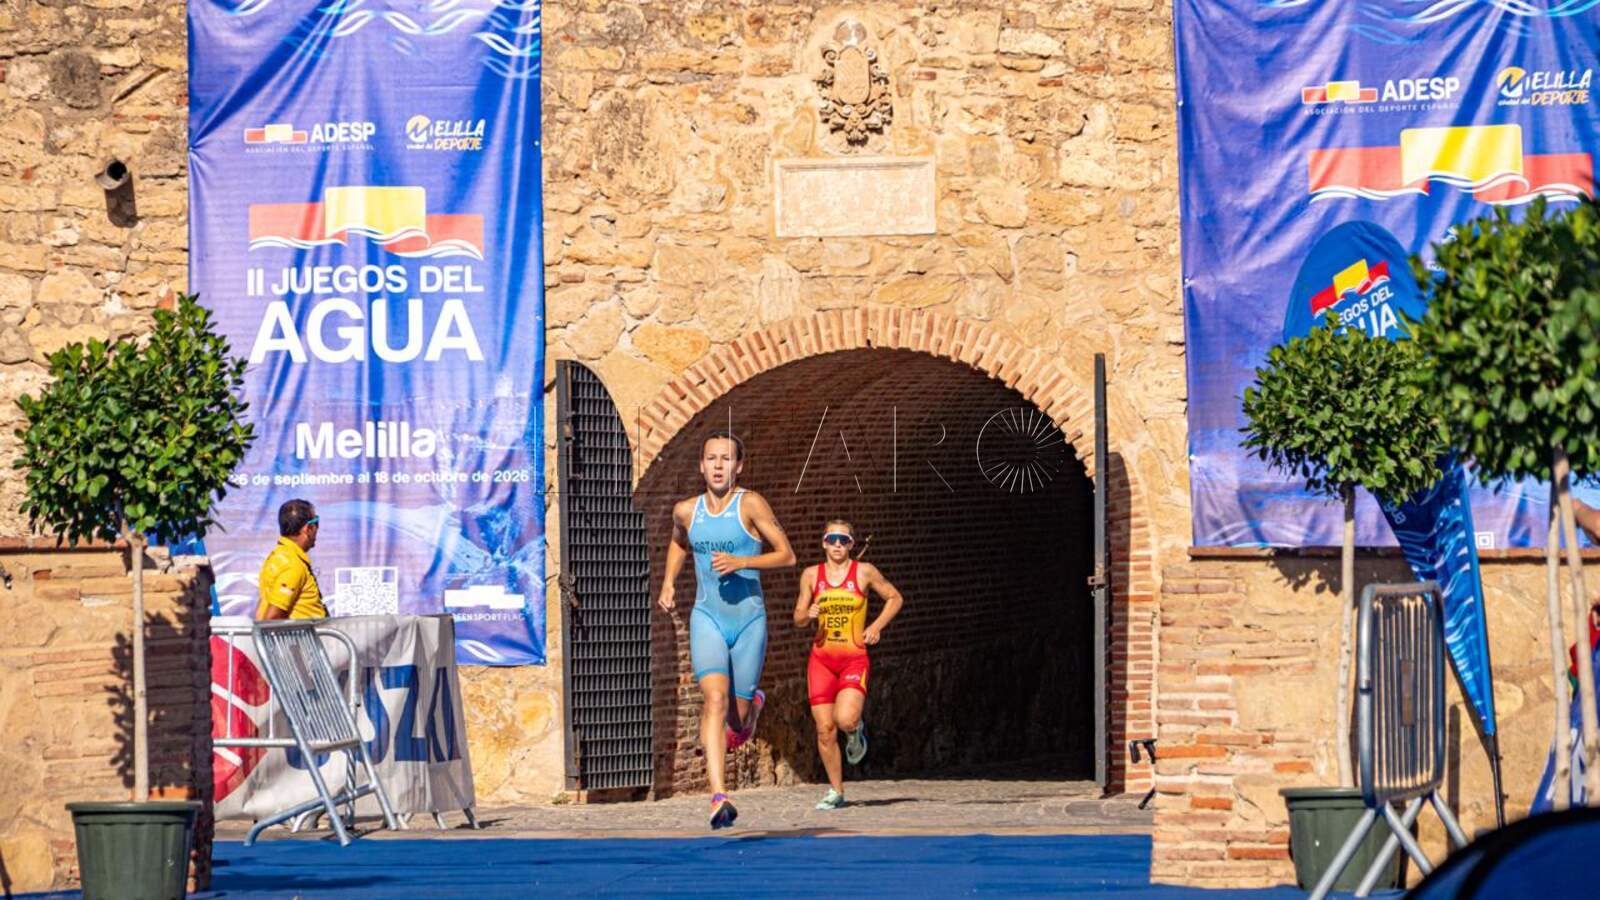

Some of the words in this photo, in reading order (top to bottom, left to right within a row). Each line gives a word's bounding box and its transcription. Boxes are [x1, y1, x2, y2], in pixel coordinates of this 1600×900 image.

[1382, 77, 1460, 102] ADESP
[310, 122, 376, 143] ADESP
[247, 268, 263, 297] II
[271, 265, 408, 296] JUEGOS
[419, 265, 484, 293] DEL
[1370, 286, 1395, 308] DEL
[248, 297, 484, 364] AGUA
[296, 421, 436, 460] Melilla
[252, 473, 270, 485] de
[274, 472, 354, 488] septiembre
[358, 471, 370, 484] al
[374, 471, 389, 483] 18
[392, 471, 410, 483] de
[414, 470, 469, 483] octubre
[472, 470, 490, 482] de
[826, 616, 848, 628] ESP
